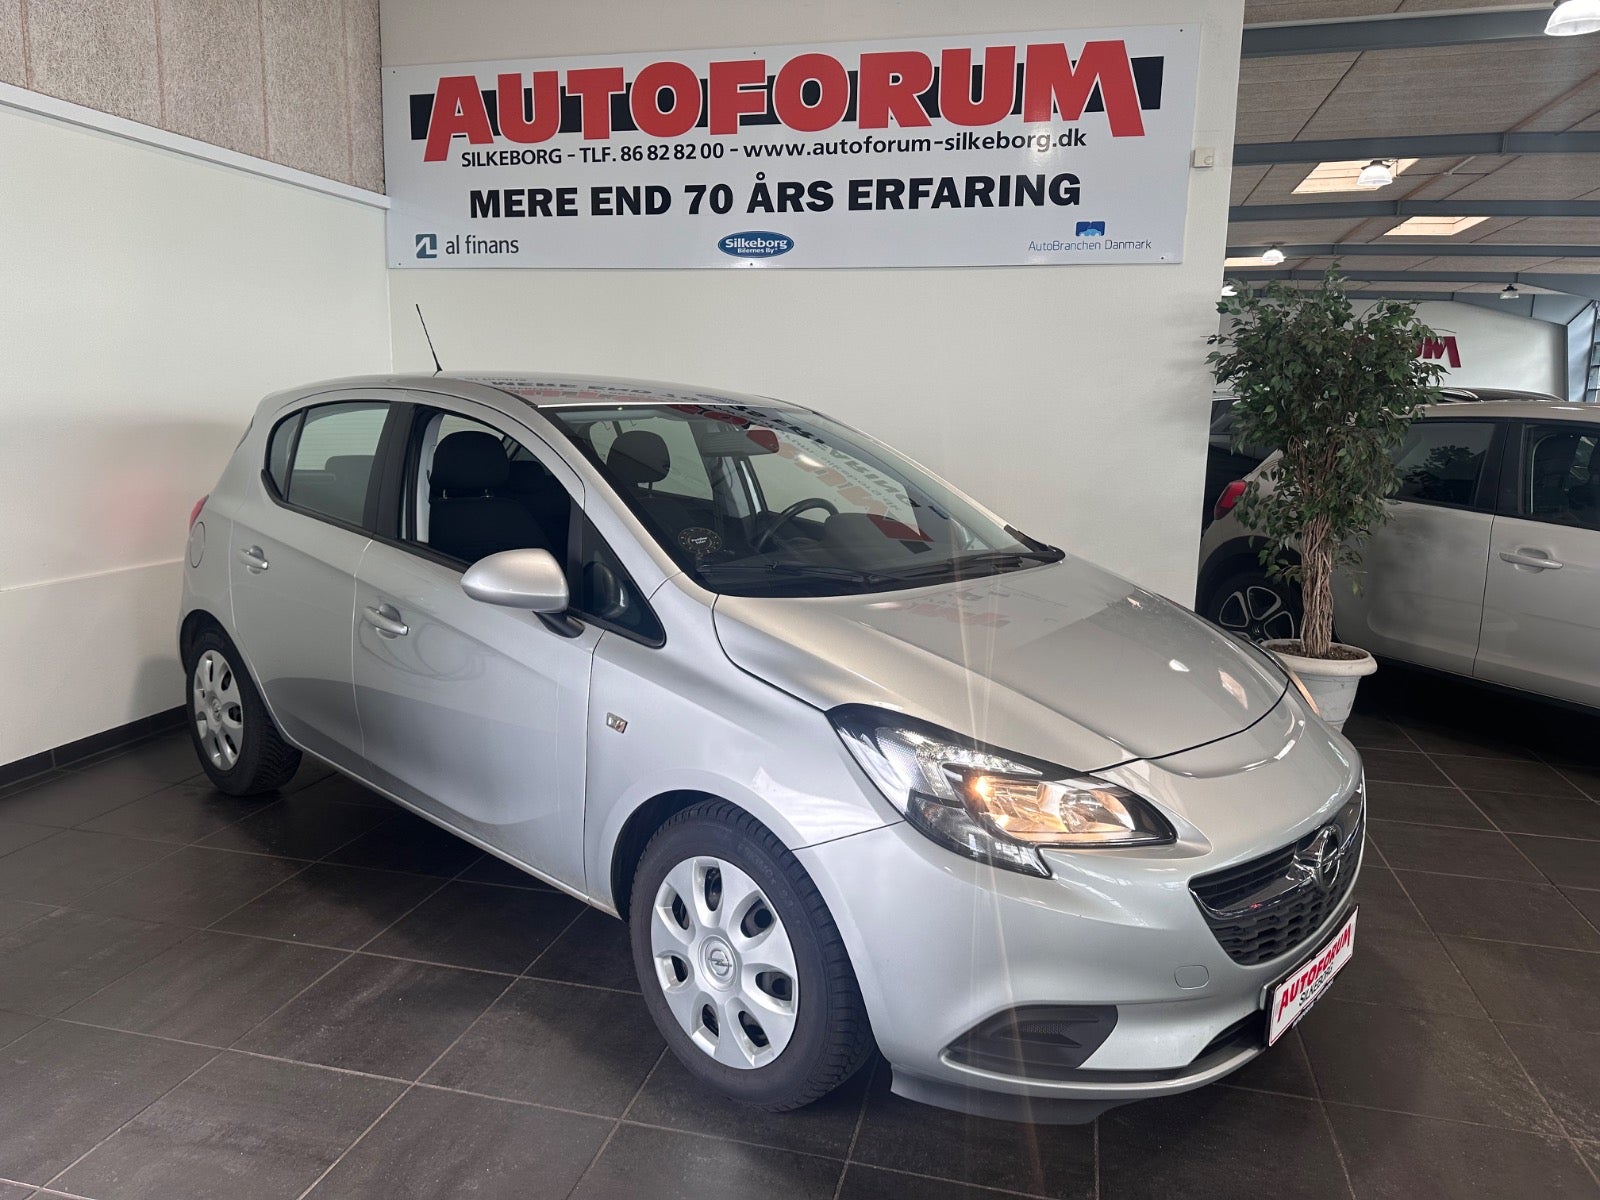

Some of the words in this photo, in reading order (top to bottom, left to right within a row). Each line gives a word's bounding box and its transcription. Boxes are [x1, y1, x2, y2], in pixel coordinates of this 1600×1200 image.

[424, 40, 1146, 162] AUTOFORUM
[461, 148, 562, 168] SILKEBORG
[579, 146, 617, 164] TLF.
[743, 128, 1087, 158] www.autoforum-silkeborg.dk
[470, 187, 579, 219] MERE
[590, 185, 672, 217] END
[683, 183, 734, 215] 70
[746, 172, 834, 214] ÅRS
[848, 172, 1081, 212] ERFARING
[445, 235, 460, 255] al
[465, 234, 520, 254] finans
[725, 237, 788, 250] Silkeborg
[1028, 240, 1101, 252] AutoBranchen
[1104, 238, 1152, 250] Danmark
[1277, 923, 1352, 1024] AUTOFORUM
